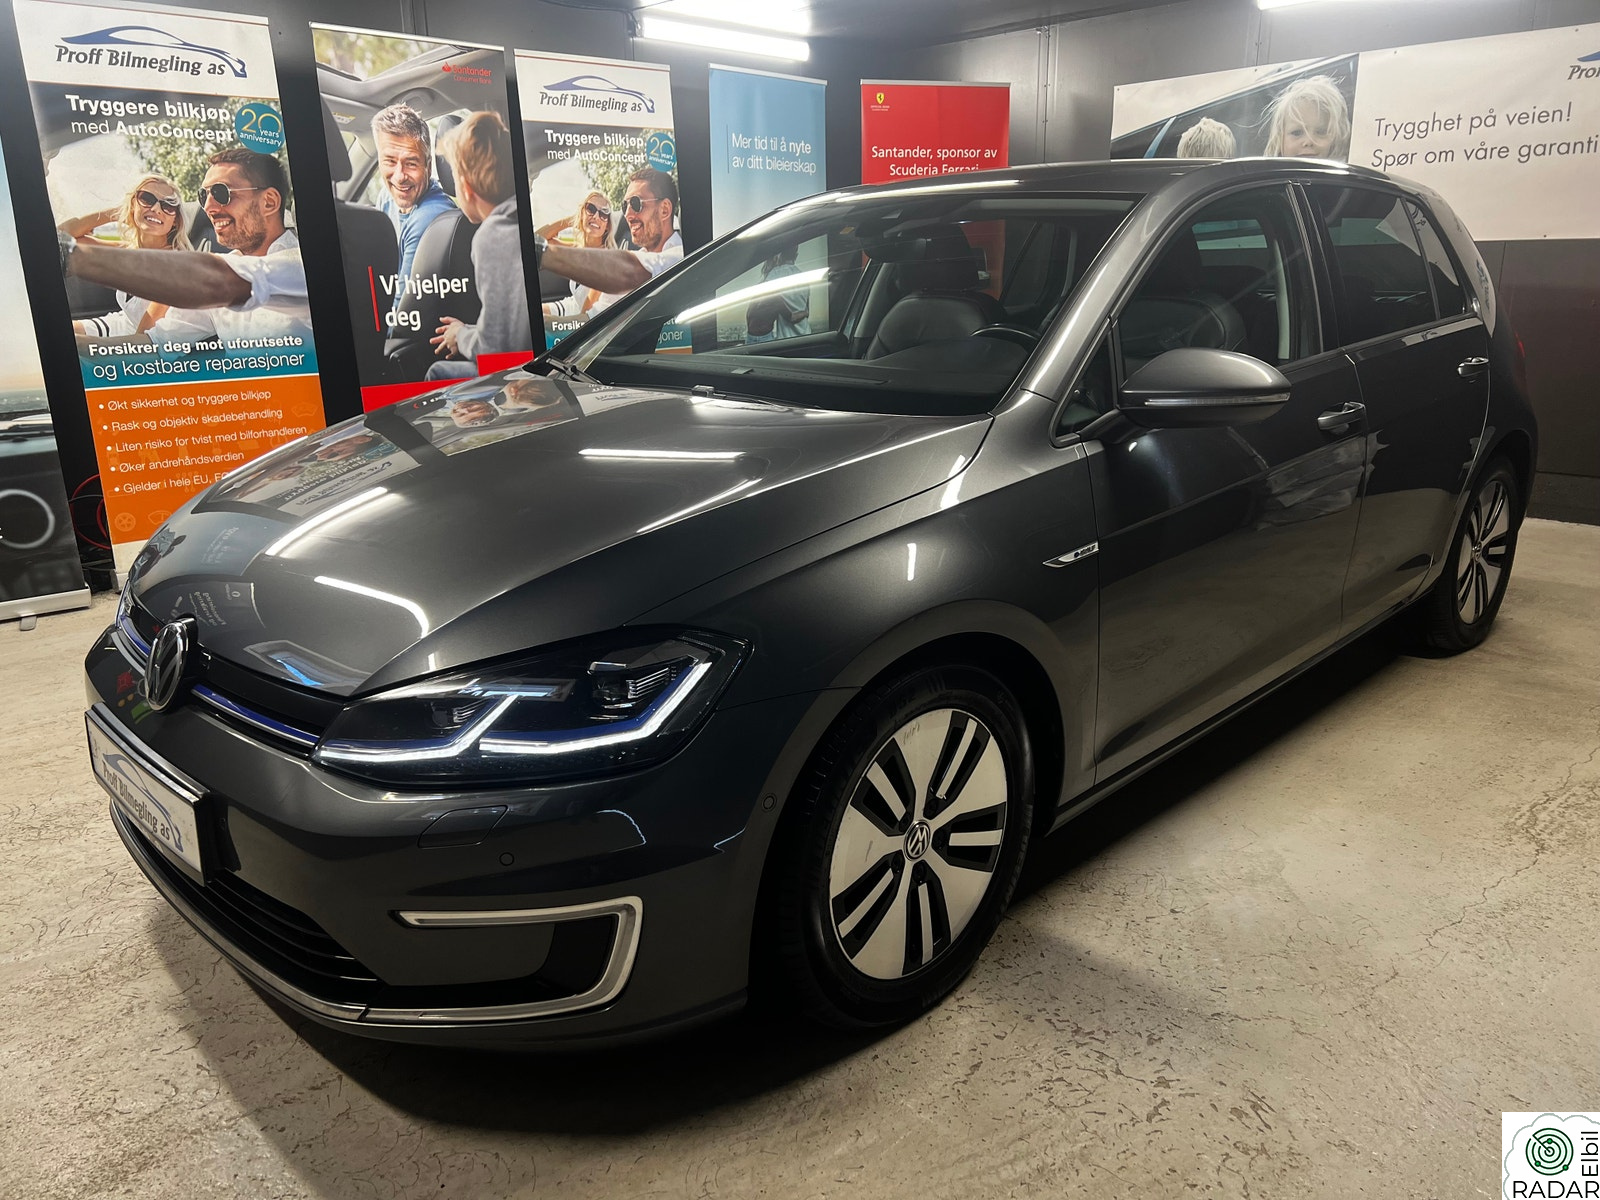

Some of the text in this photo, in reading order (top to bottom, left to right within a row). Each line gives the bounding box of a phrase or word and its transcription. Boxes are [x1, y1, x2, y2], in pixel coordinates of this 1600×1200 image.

[54, 44, 226, 76] Proff Bilmegling as
[65, 94, 231, 123] Tryggere bilkjøp
[539, 91, 642, 113] Proff Bilmegling as
[71, 120, 234, 143] med AutoConcept
[241, 108, 282, 133] 20
[1375, 101, 1572, 141] Trygghet på veien!
[239, 132, 282, 147] anniversary
[259, 128, 280, 138] years
[544, 129, 644, 148] Tryggere bilkjøp
[731, 132, 812, 156] Mer tid til å nyte
[547, 149, 646, 164] med AutoConcept
[871, 145, 998, 161] Santander, sponsor av
[1371, 148, 1418, 172] Spør
[1424, 149, 1455, 164] om
[1464, 141, 1510, 161] våre
[732, 155, 817, 176] av ditt bileierskap
[889, 163, 939, 176] Scuderia
[379, 273, 469, 300] Vi hjelper
[385, 306, 421, 331] deg
[88, 335, 303, 356] Forsikrer deg mot uforutsette
[93, 353, 305, 381] og kostbare reparasjoner
[107, 390, 272, 411] Økt sikkerhet og tryggere bilkjøp
[111, 409, 283, 432] Rask og objektiv skadebehandling
[115, 426, 307, 453] Liten risiko for tvist med bilforhandleren
[119, 452, 244, 473] Øker andrehåndsverdien
[123, 481, 161, 494] Gjelder
[169, 477, 191, 488] hele
[193, 474, 212, 484] EU,
[102, 759, 171, 841] Proff Bilmegling as
